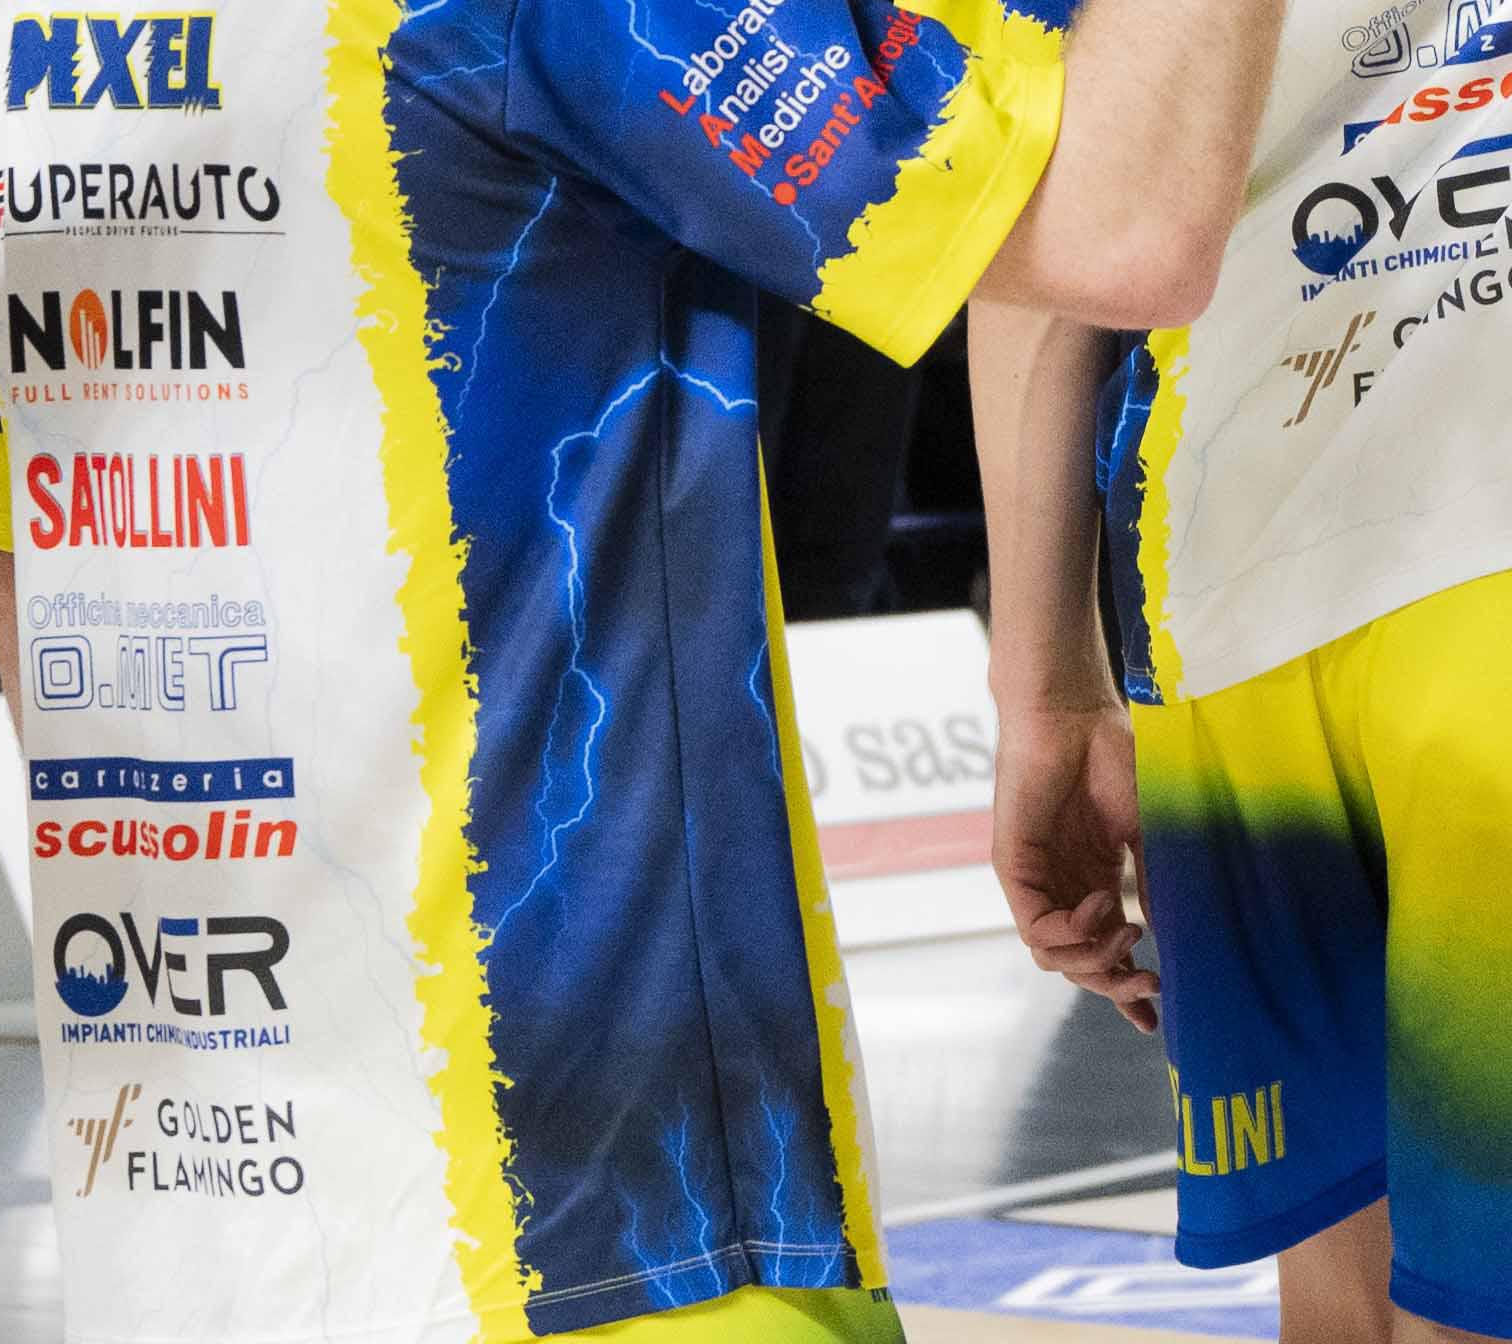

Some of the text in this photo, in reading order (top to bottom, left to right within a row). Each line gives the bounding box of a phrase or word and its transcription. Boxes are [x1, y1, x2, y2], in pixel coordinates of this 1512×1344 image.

[699, 36, 796, 148] Analisi
[729, 43, 851, 176] Mediche
[106, 226, 136, 236] DRIVE
[140, 226, 179, 236] FUTURE
[1383, 242, 1469, 274] CHIMICI
[7, 288, 246, 373] NOLFIN
[12, 383, 250, 404] FULL RENT SOLUTIONS
[26, 452, 251, 550] SATOLLINI
[845, 713, 995, 792] sas
[33, 810, 298, 861] scussolin
[53, 912, 291, 1017] OVER
[61, 1023, 142, 1043] IMPIANTI
[158, 1098, 297, 1144] GOLDEN
[127, 1151, 304, 1197] FLAMINGO
